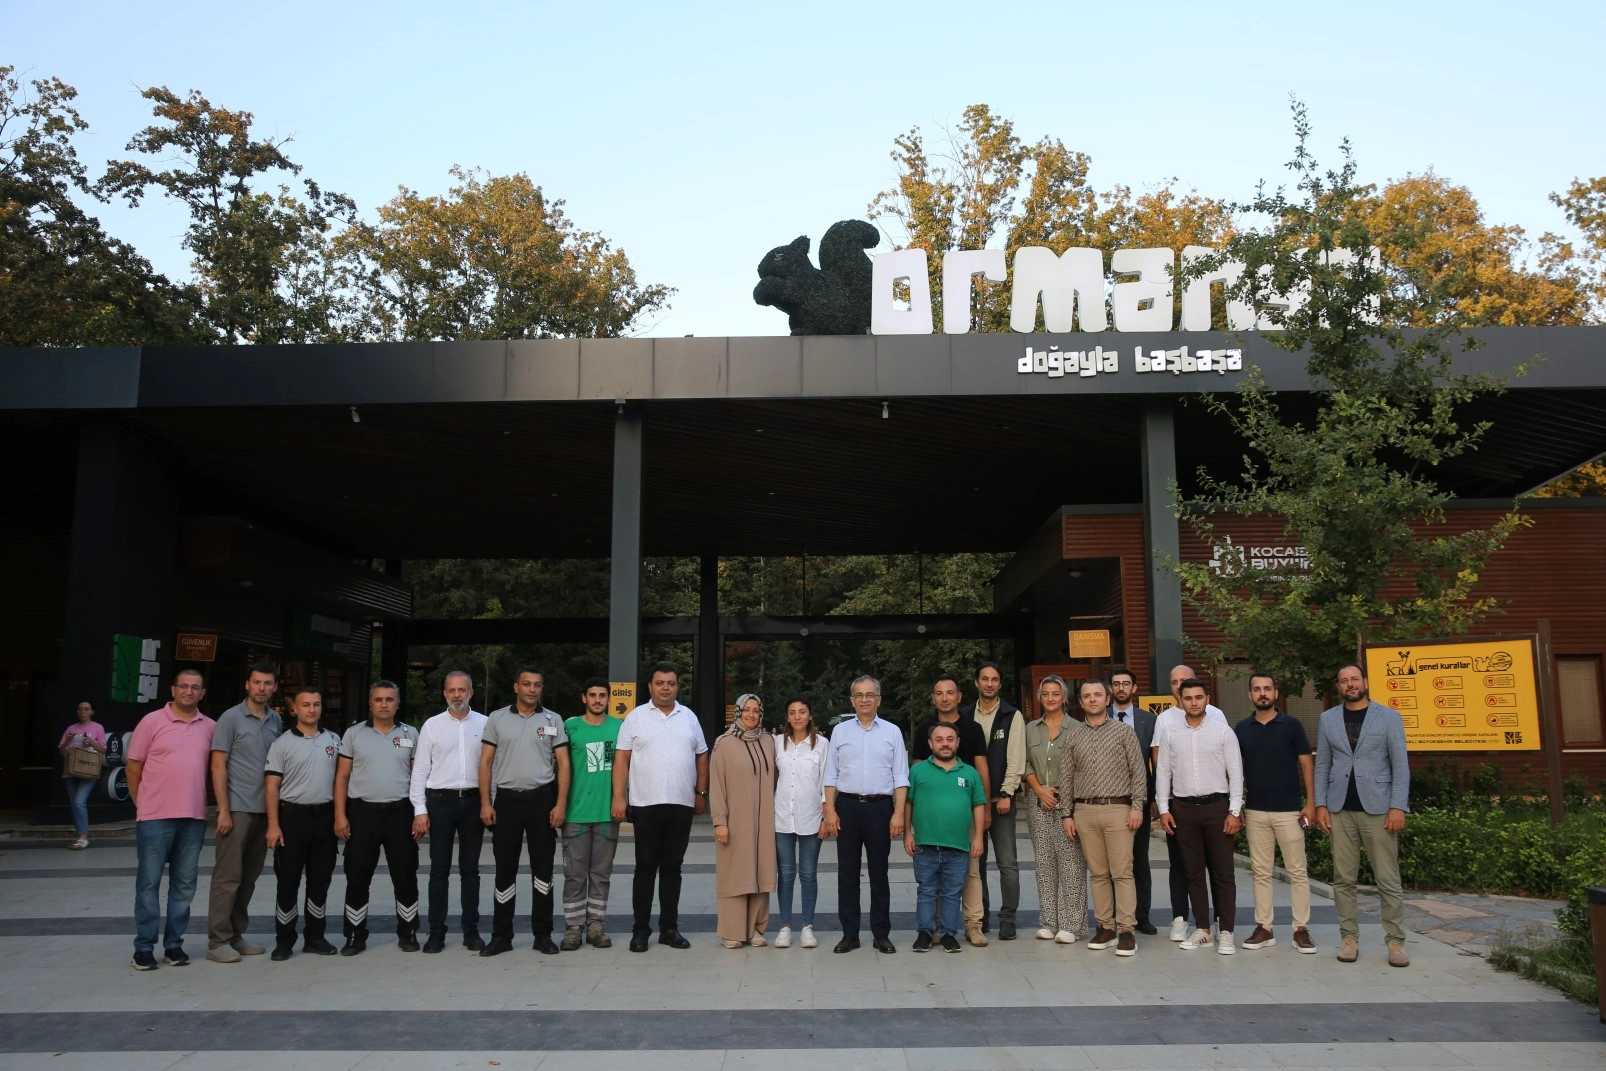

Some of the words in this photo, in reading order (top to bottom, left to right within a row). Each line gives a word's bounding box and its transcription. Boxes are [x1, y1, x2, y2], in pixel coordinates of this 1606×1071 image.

[1017, 345, 1119, 378] doğayla
[1134, 345, 1243, 376] başbaşa
[1250, 546, 1311, 557] KOCAE
[1419, 663, 1439, 671] genel
[1440, 661, 1471, 669] kurallar
[613, 688, 632, 698] GİRİŞ
